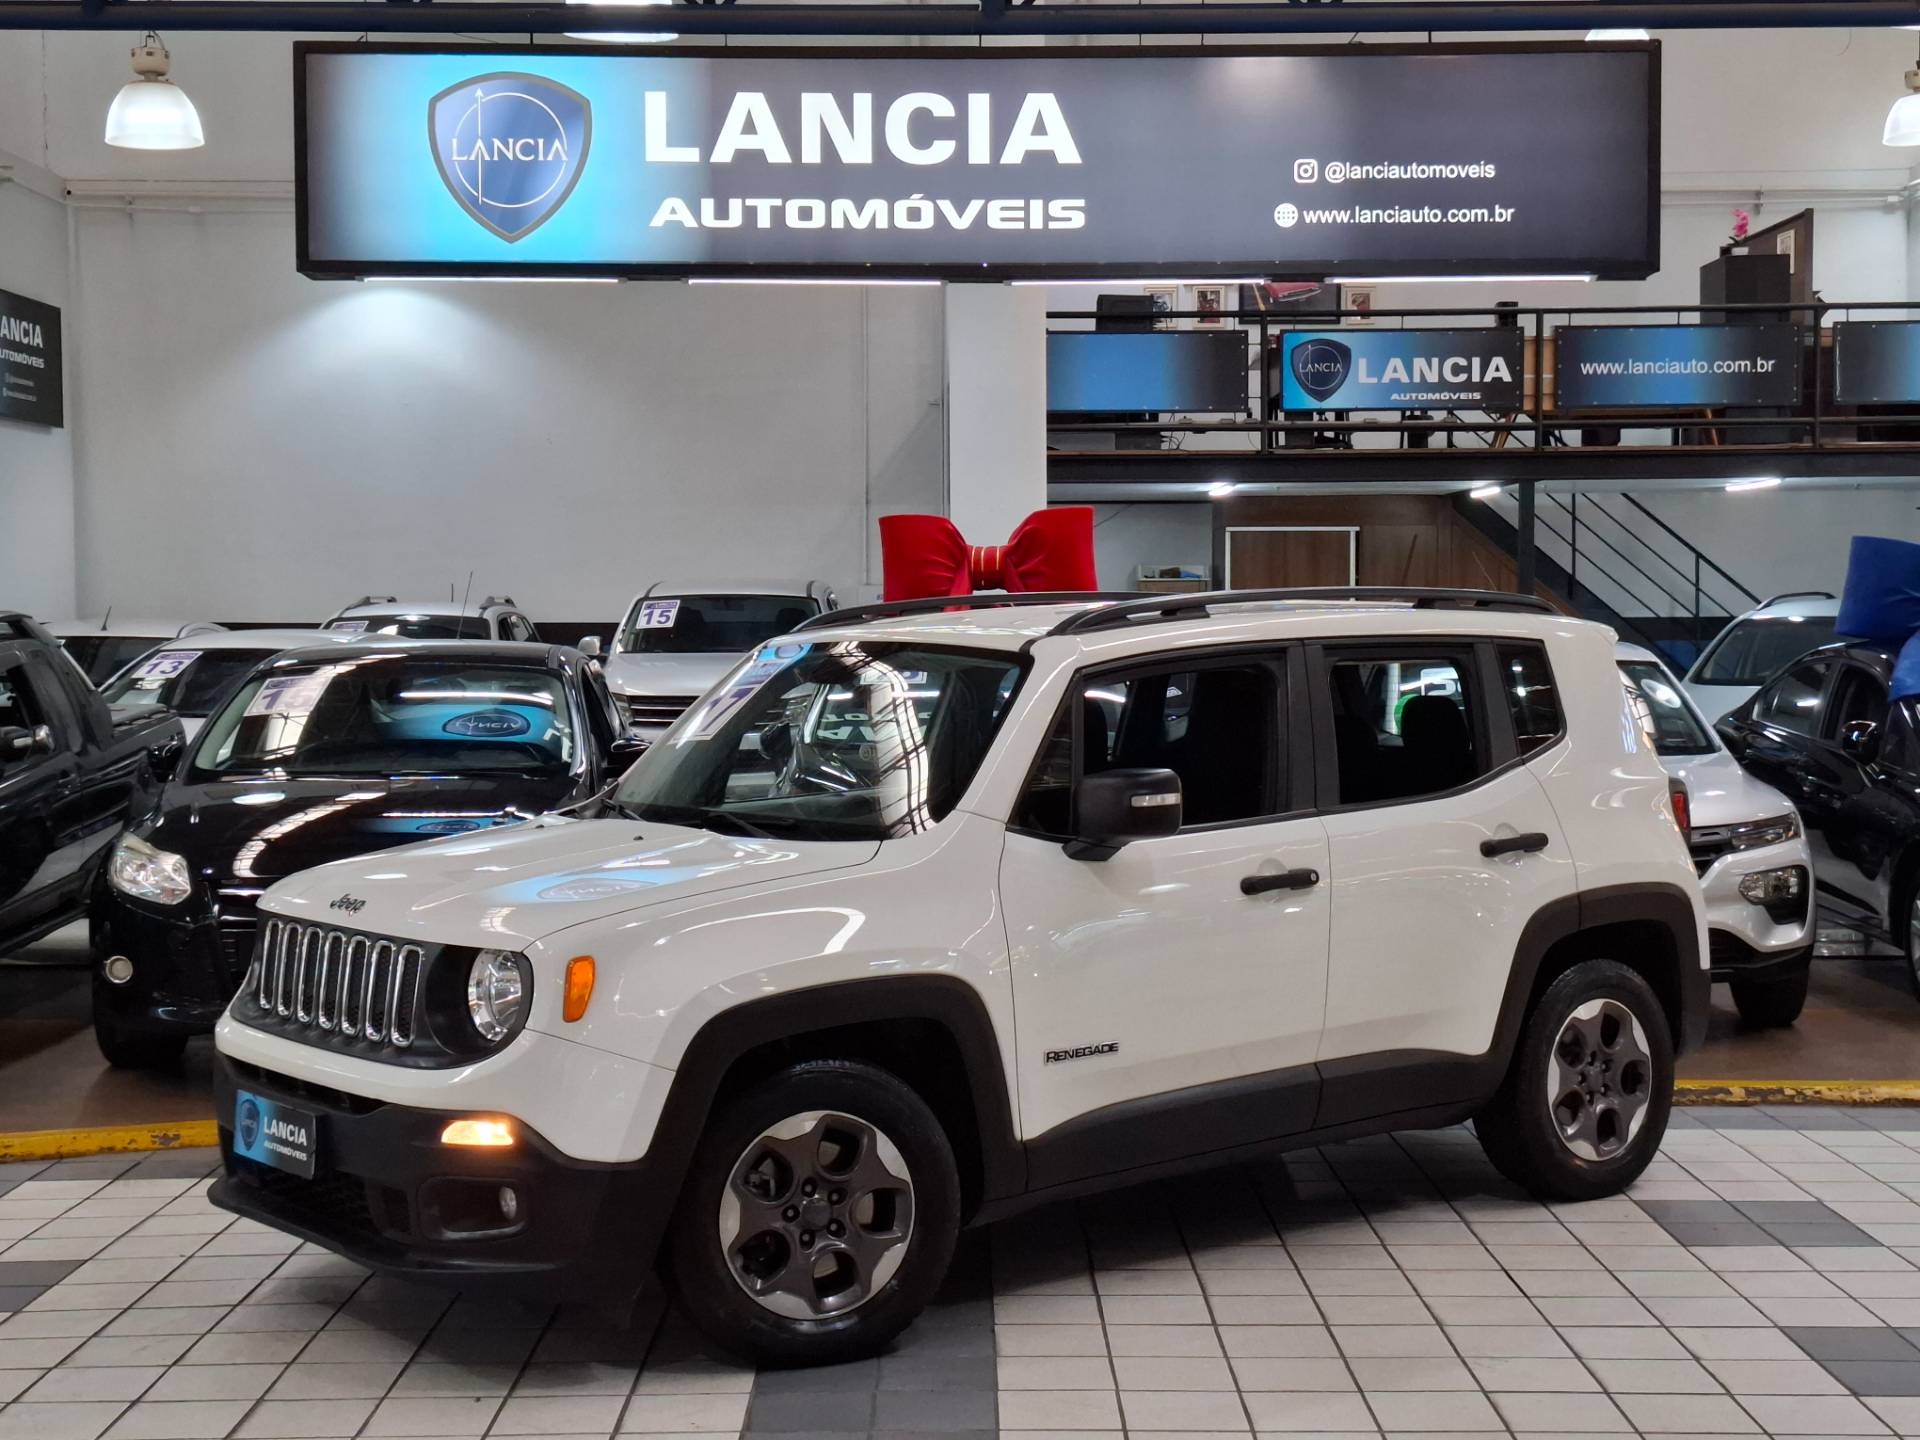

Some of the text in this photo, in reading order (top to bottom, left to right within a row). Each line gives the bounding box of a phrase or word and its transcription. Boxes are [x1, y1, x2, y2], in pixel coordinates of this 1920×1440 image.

[645, 91, 1083, 165] LANCIA
[452, 138, 568, 161] LANCIA
[1324, 161, 1496, 183] @lanciautomoveis
[649, 194, 1086, 230] AUTOMÓVEIS
[1303, 205, 1516, 224] www.lanciauto.com.br
[0, 315, 43, 348] ANCIA
[0, 348, 45, 368] UTOMÓVEIS
[1300, 362, 1343, 373] LANCIA
[1580, 357, 1775, 375] www.lanciauto.com.br
[1358, 356, 1513, 384] LANCIA
[1390, 391, 1482, 401] AUTOMÓVEIS
[643, 609, 673, 625] 15
[145, 660, 185, 675] 13
[1045, 1042, 1119, 1063] RENEGADE
[264, 1115, 308, 1147] LANCIA
[264, 1140, 308, 1161] AUTOMÓVEIS
